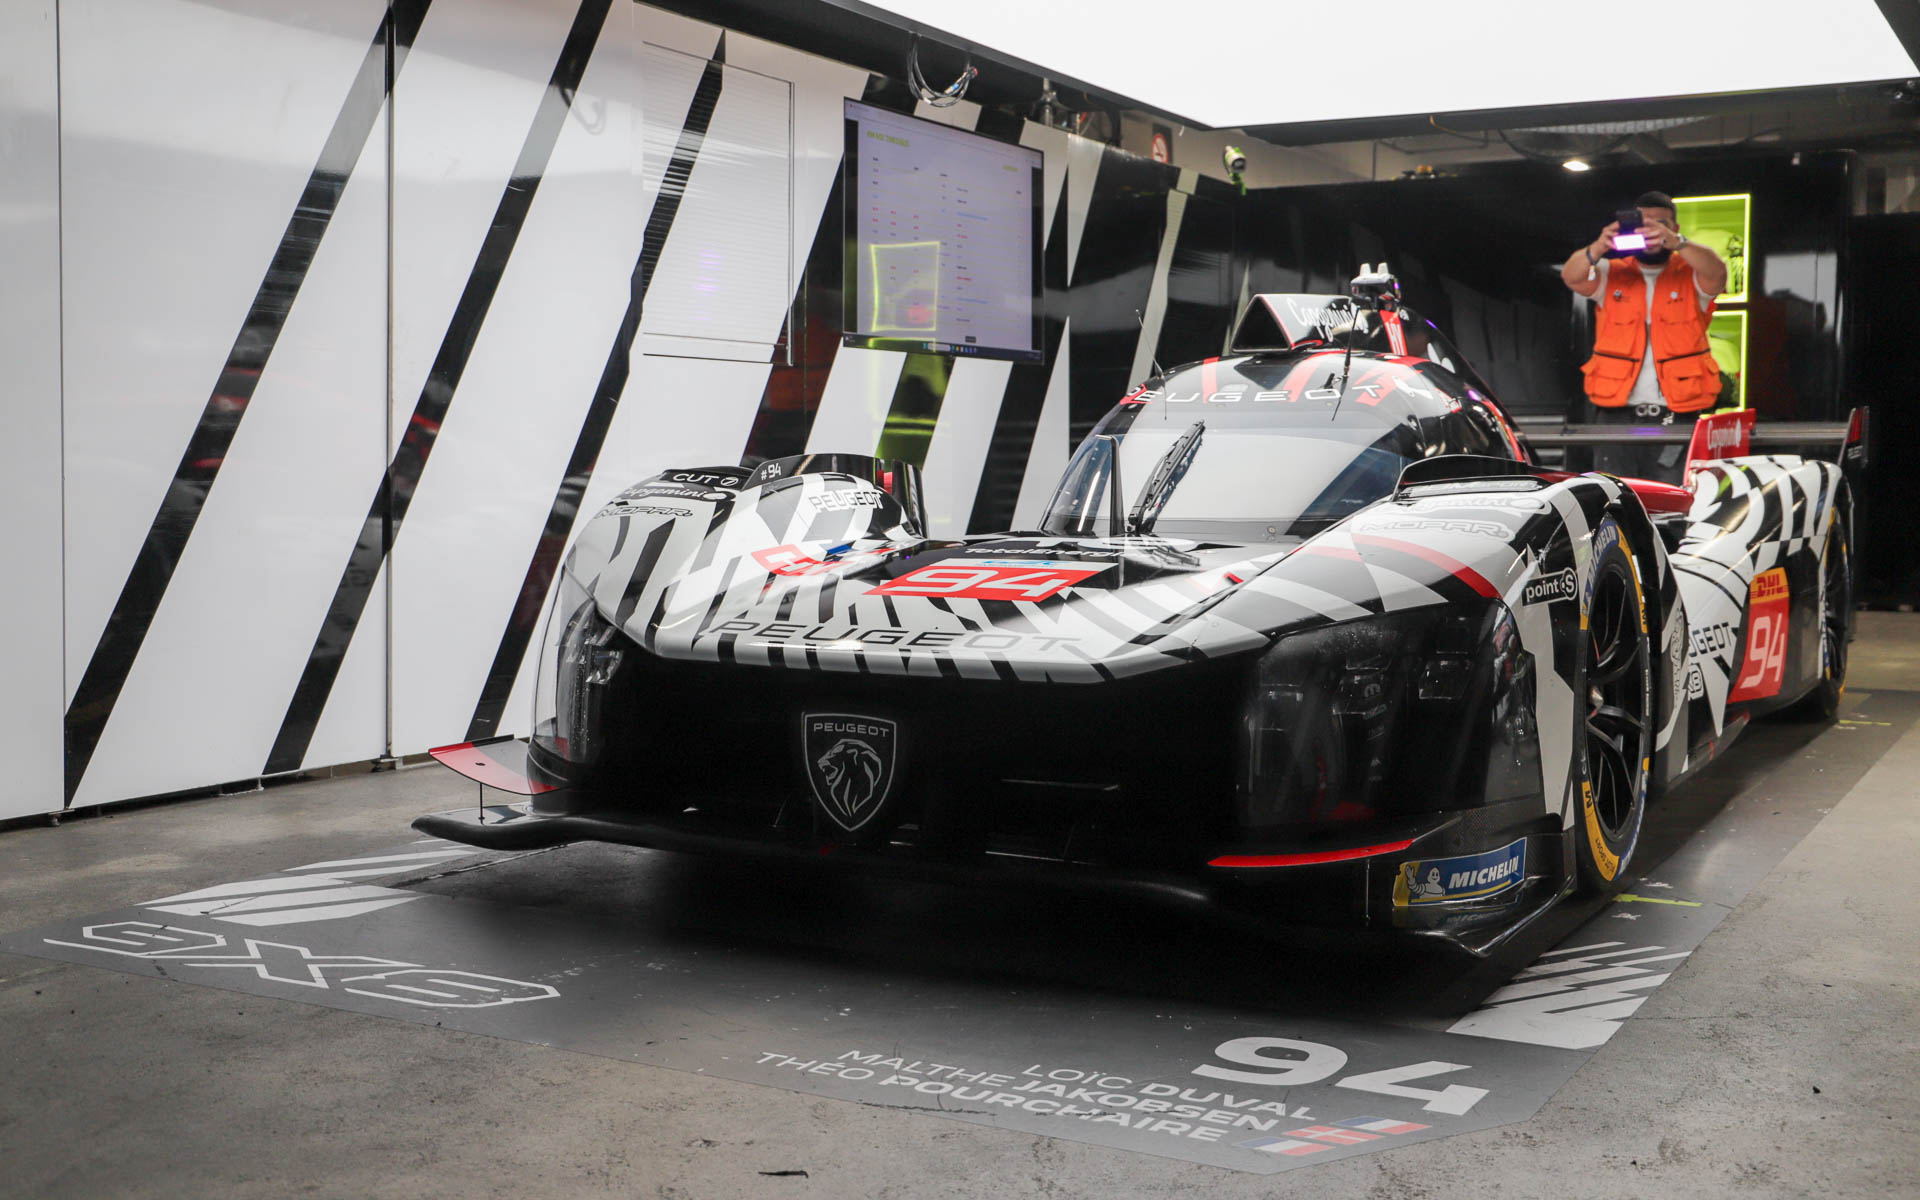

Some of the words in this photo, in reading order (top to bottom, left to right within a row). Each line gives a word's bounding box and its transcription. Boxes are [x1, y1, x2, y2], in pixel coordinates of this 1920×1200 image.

[1127, 384, 1380, 403] PEUGEOT
[672, 473, 719, 484] CUT
[760, 462, 782, 481] #94
[808, 488, 884, 513] PEUGEOT
[888, 567, 1069, 598] 94
[1525, 578, 1560, 603] point
[1756, 573, 1784, 598] DHL
[709, 621, 1082, 651] PEUGEOT
[1687, 621, 1732, 658] UGEOT
[1740, 612, 1786, 689] 94
[812, 721, 890, 738] PEUGEOT
[1447, 854, 1520, 890] MICHELIN
[836, 1050, 1016, 1089] MALTHE
[1011, 1079, 1279, 1131] JAKOBSEN
[1191, 1036, 1490, 1117] 94
[756, 1051, 874, 1080] THÉO
[878, 1074, 1229, 1142] POURCHAIRE
[1139, 1082, 1317, 1122] DUVAL
